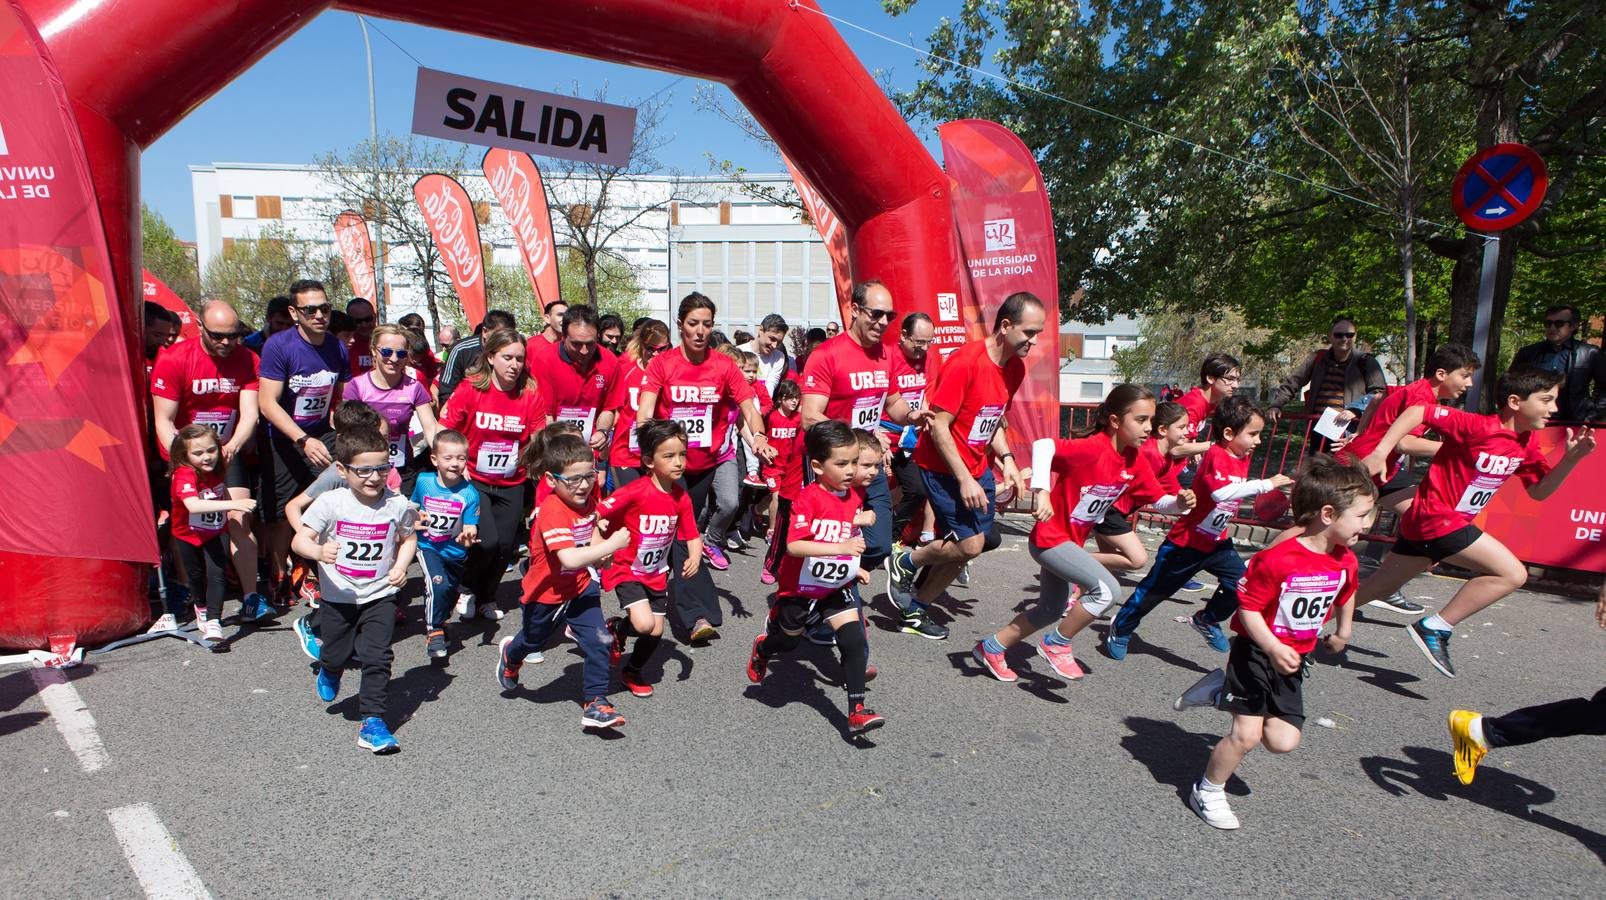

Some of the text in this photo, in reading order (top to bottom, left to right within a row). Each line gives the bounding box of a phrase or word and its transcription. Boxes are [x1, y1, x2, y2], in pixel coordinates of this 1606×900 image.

[443, 87, 608, 154] SALIDA
[967, 254, 1037, 268] UNIVERSIDAD
[972, 265, 1033, 278] DE LA RIOJA
[943, 335, 953, 344] LA
[192, 378, 219, 395] UR
[849, 371, 876, 391] UR
[898, 374, 917, 389] UR
[670, 385, 700, 403] UR
[303, 397, 327, 411] 225
[476, 411, 504, 432] UR
[859, 406, 879, 426] 045
[772, 427, 790, 439] UR
[980, 418, 998, 434] 016
[487, 453, 510, 467] 177
[1475, 451, 1510, 475] UR
[430, 513, 459, 530] 227
[639, 514, 670, 535] UR
[811, 518, 841, 543] UR
[1575, 526, 1602, 541] DE
[345, 541, 384, 561] 222
[811, 561, 849, 581] 029
[1291, 595, 1334, 619] 065
